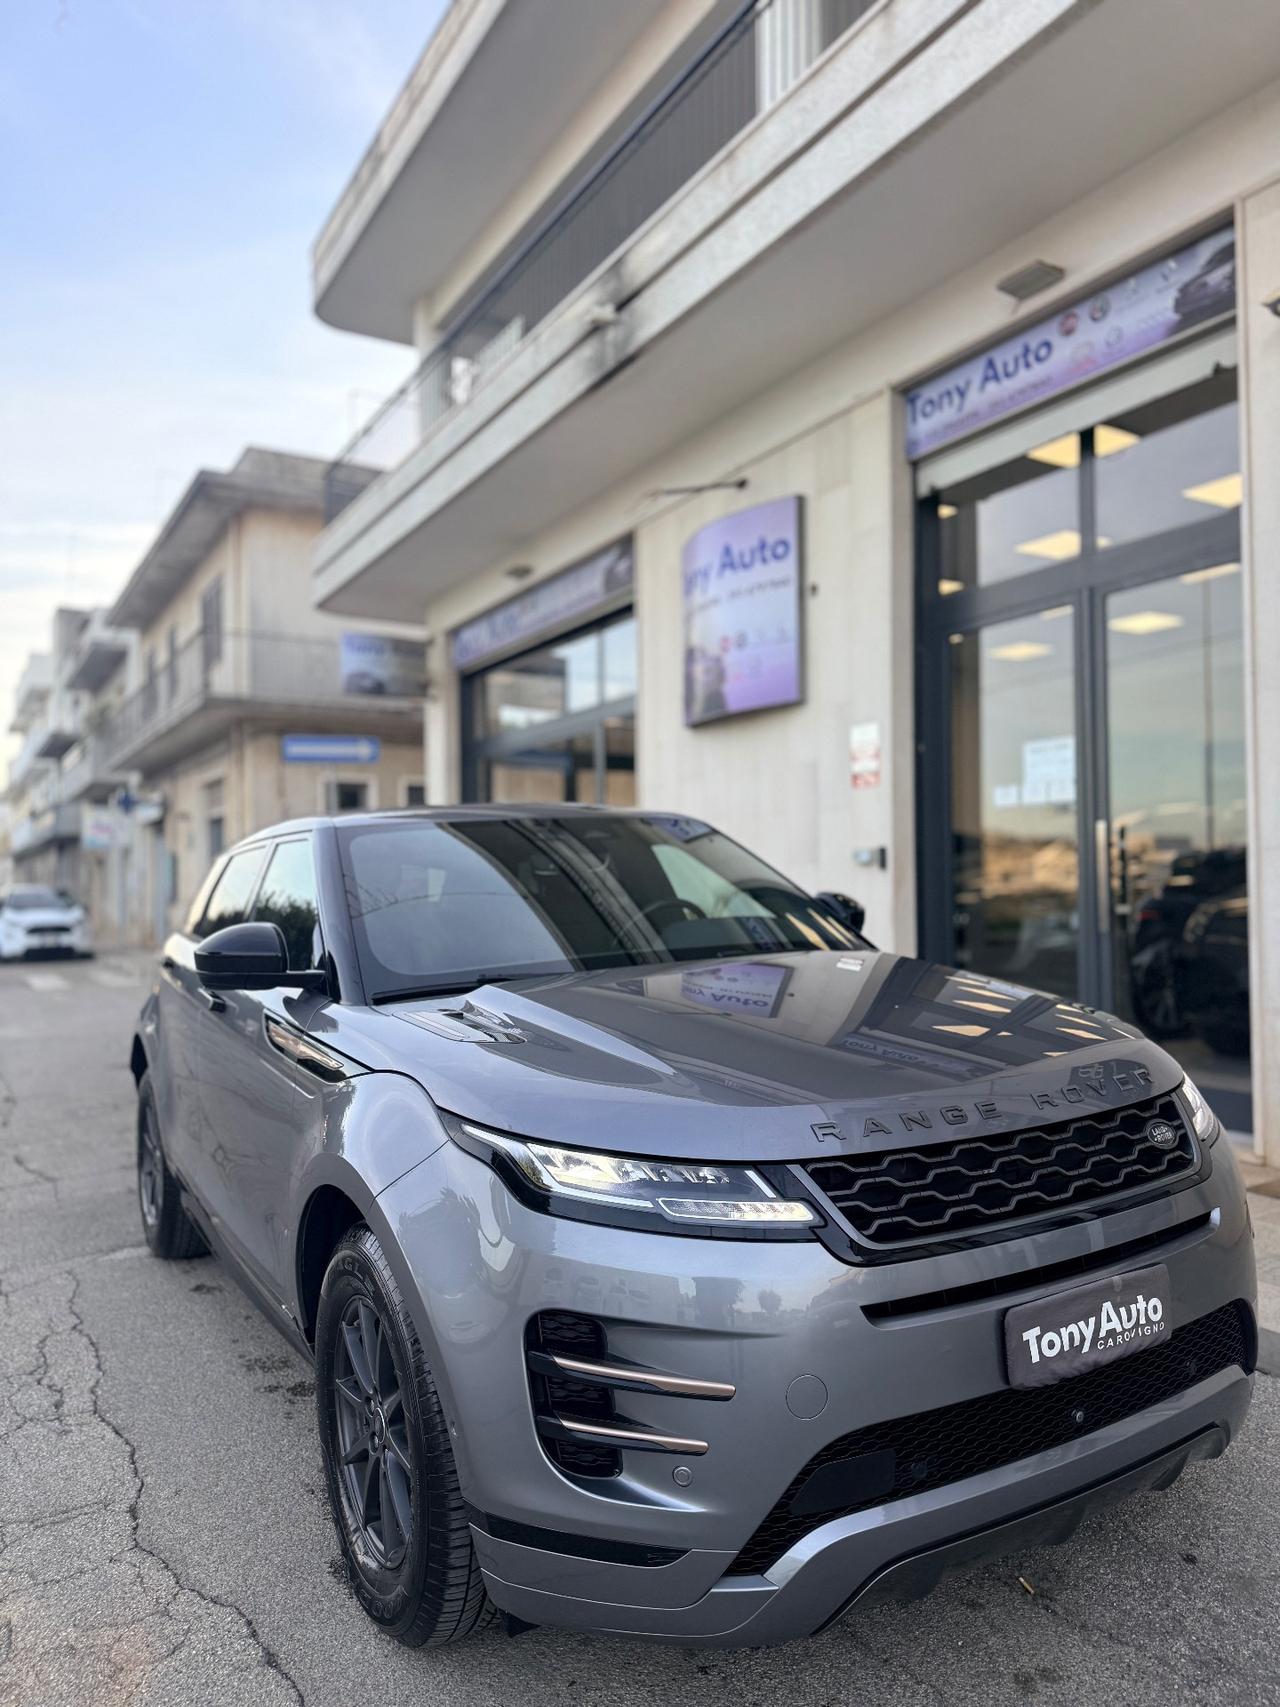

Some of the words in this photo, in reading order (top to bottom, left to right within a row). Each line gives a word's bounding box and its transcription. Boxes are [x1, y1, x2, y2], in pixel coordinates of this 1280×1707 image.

[906, 378, 971, 425] Tony
[978, 340, 1053, 393] Auto
[717, 537, 790, 578] Auto
[810, 1101, 1002, 1143] RANGE
[1031, 1067, 1153, 1110] ROVER
[1022, 1316, 1096, 1364] Tony
[1098, 1294, 1163, 1339] Auto
[1097, 1321, 1165, 1350] CAROVIGNO
